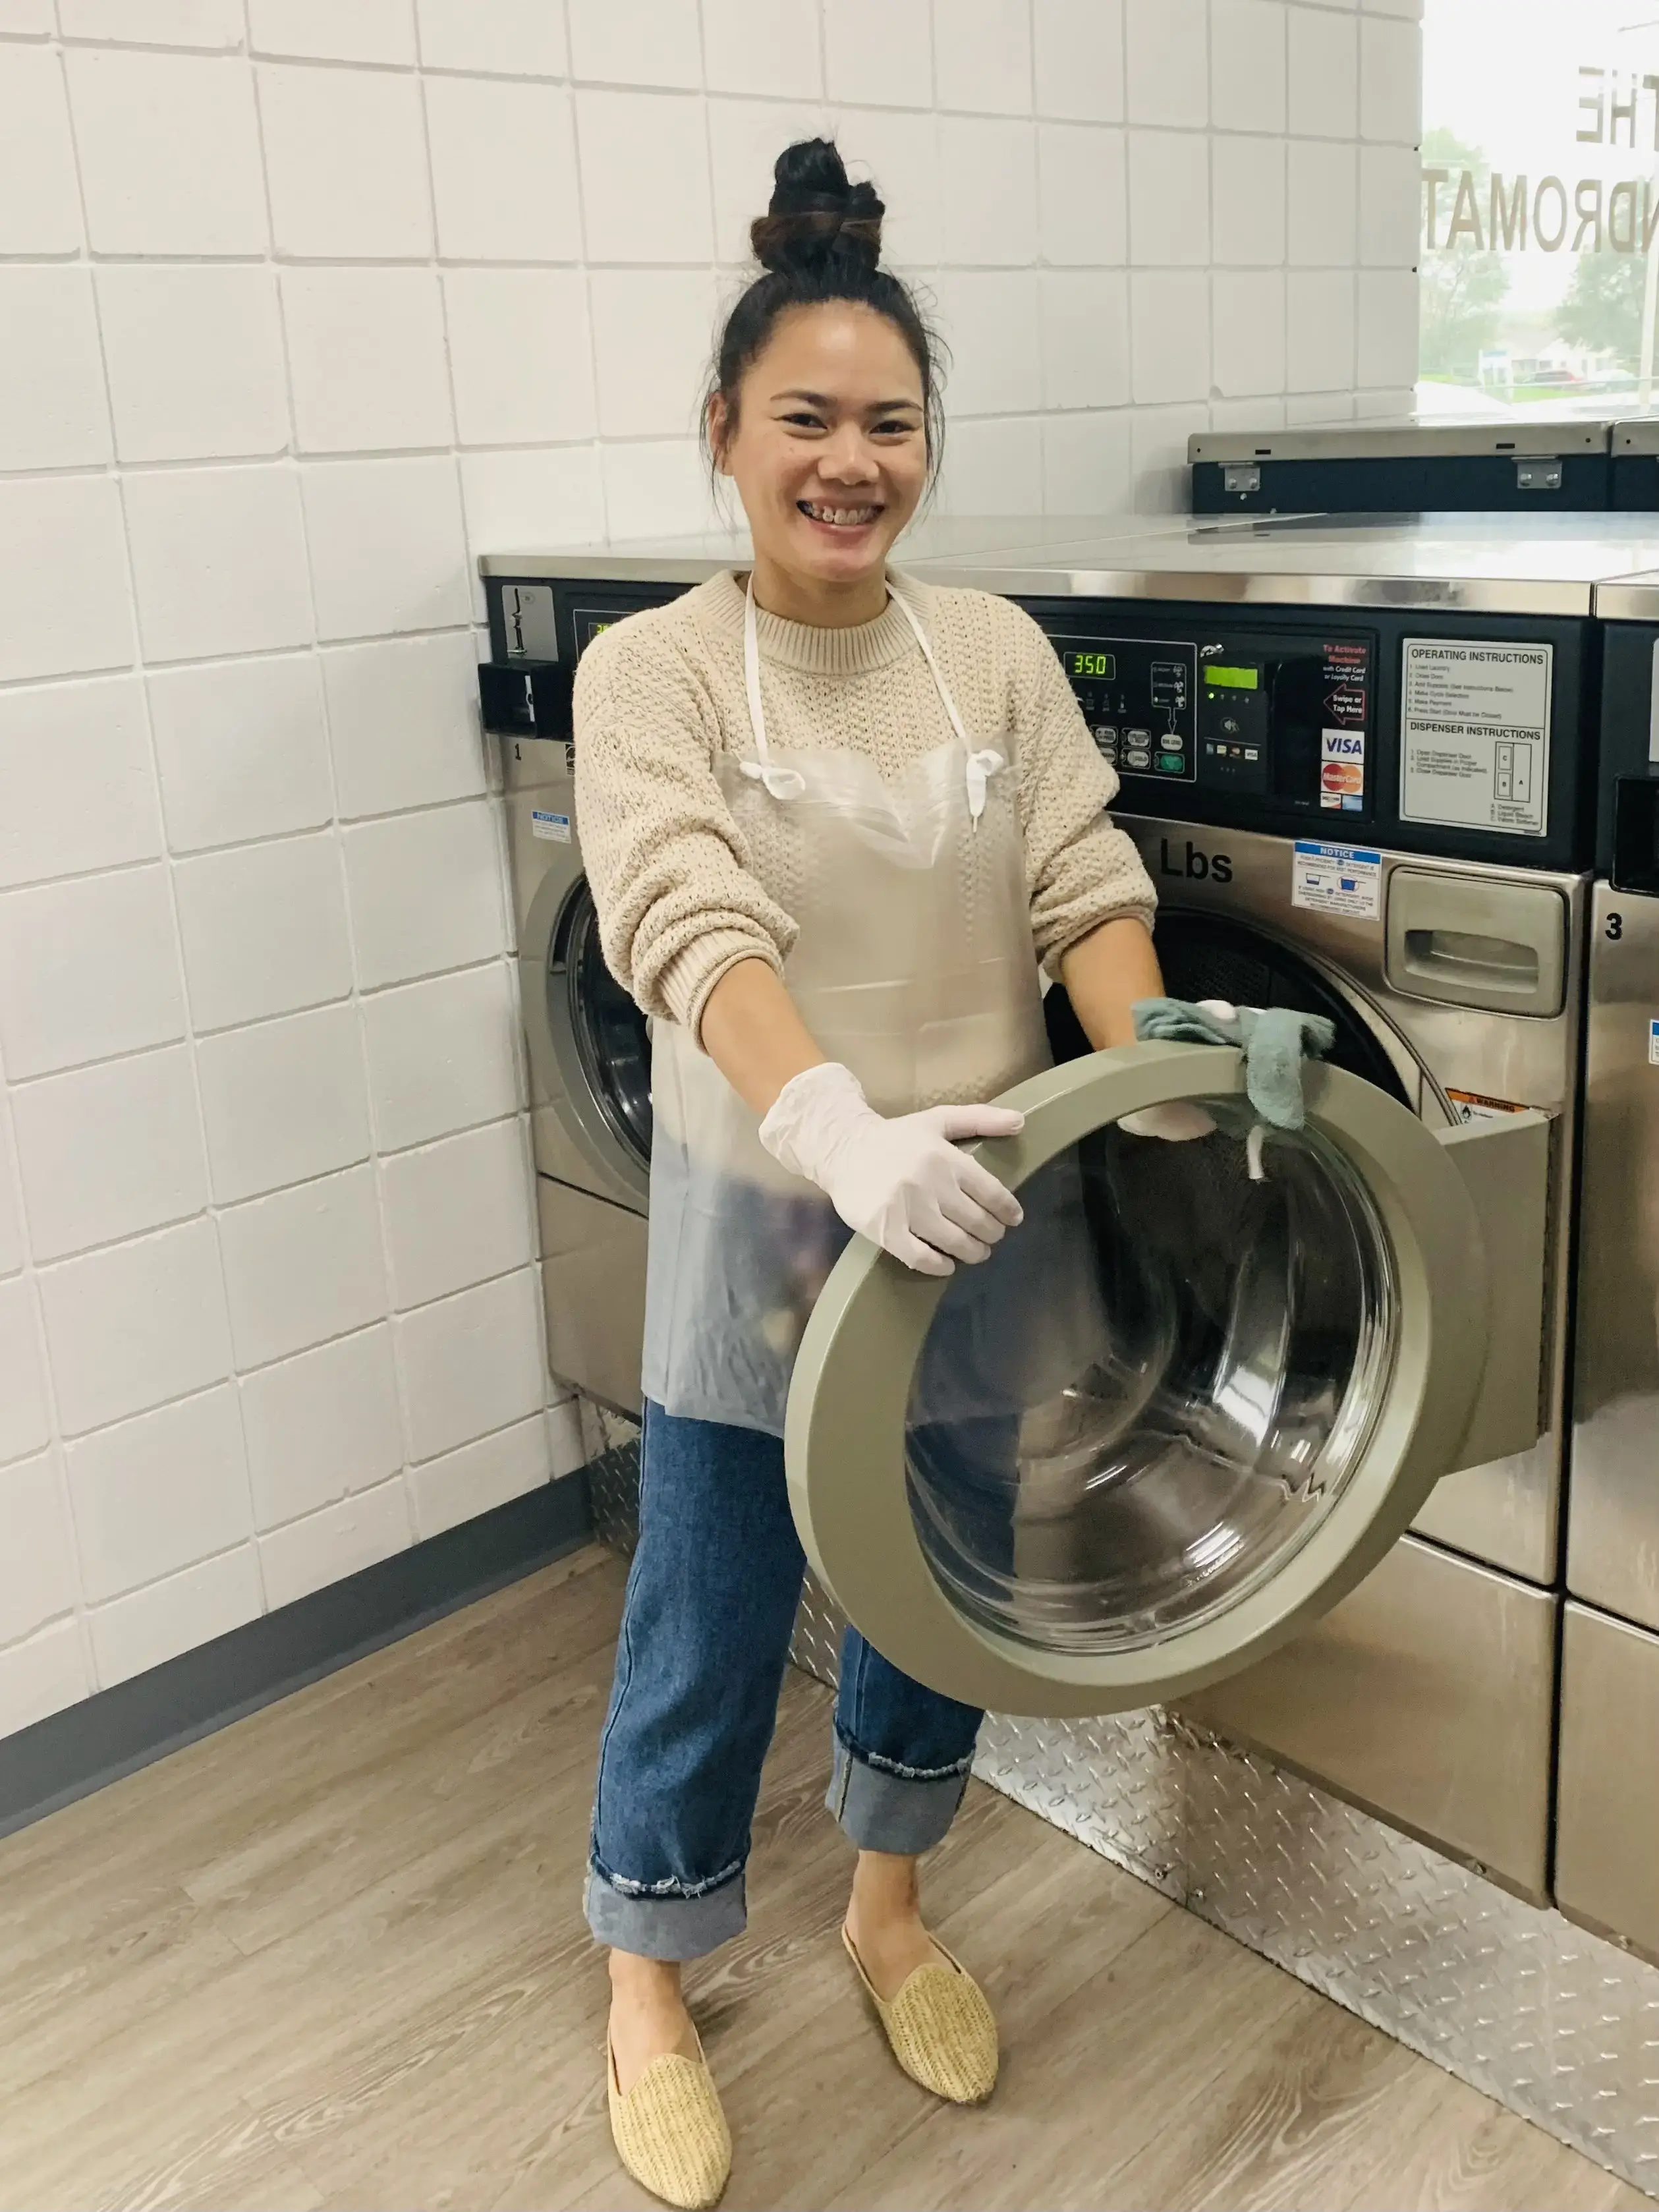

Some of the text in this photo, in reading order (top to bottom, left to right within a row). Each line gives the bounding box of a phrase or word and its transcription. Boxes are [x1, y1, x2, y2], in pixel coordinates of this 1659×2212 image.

[1075, 654, 1106, 675] 350
[1411, 648, 1544, 665] OPERATING INSTRUCTIONS
[1333, 695, 1353, 704] Swipe
[1333, 704, 1363, 714] Tap Here
[1410, 722, 1540, 740] DISPENSER INSTRUCTIONS
[515, 743, 522, 761] 1
[1326, 737, 1363, 754] VISA
[1161, 837, 1233, 883] Lbs
[1320, 847, 1355, 859] NOTICE
[1605, 912, 1623, 941] 3
[1476, 1097, 1516, 1114] WARNING
